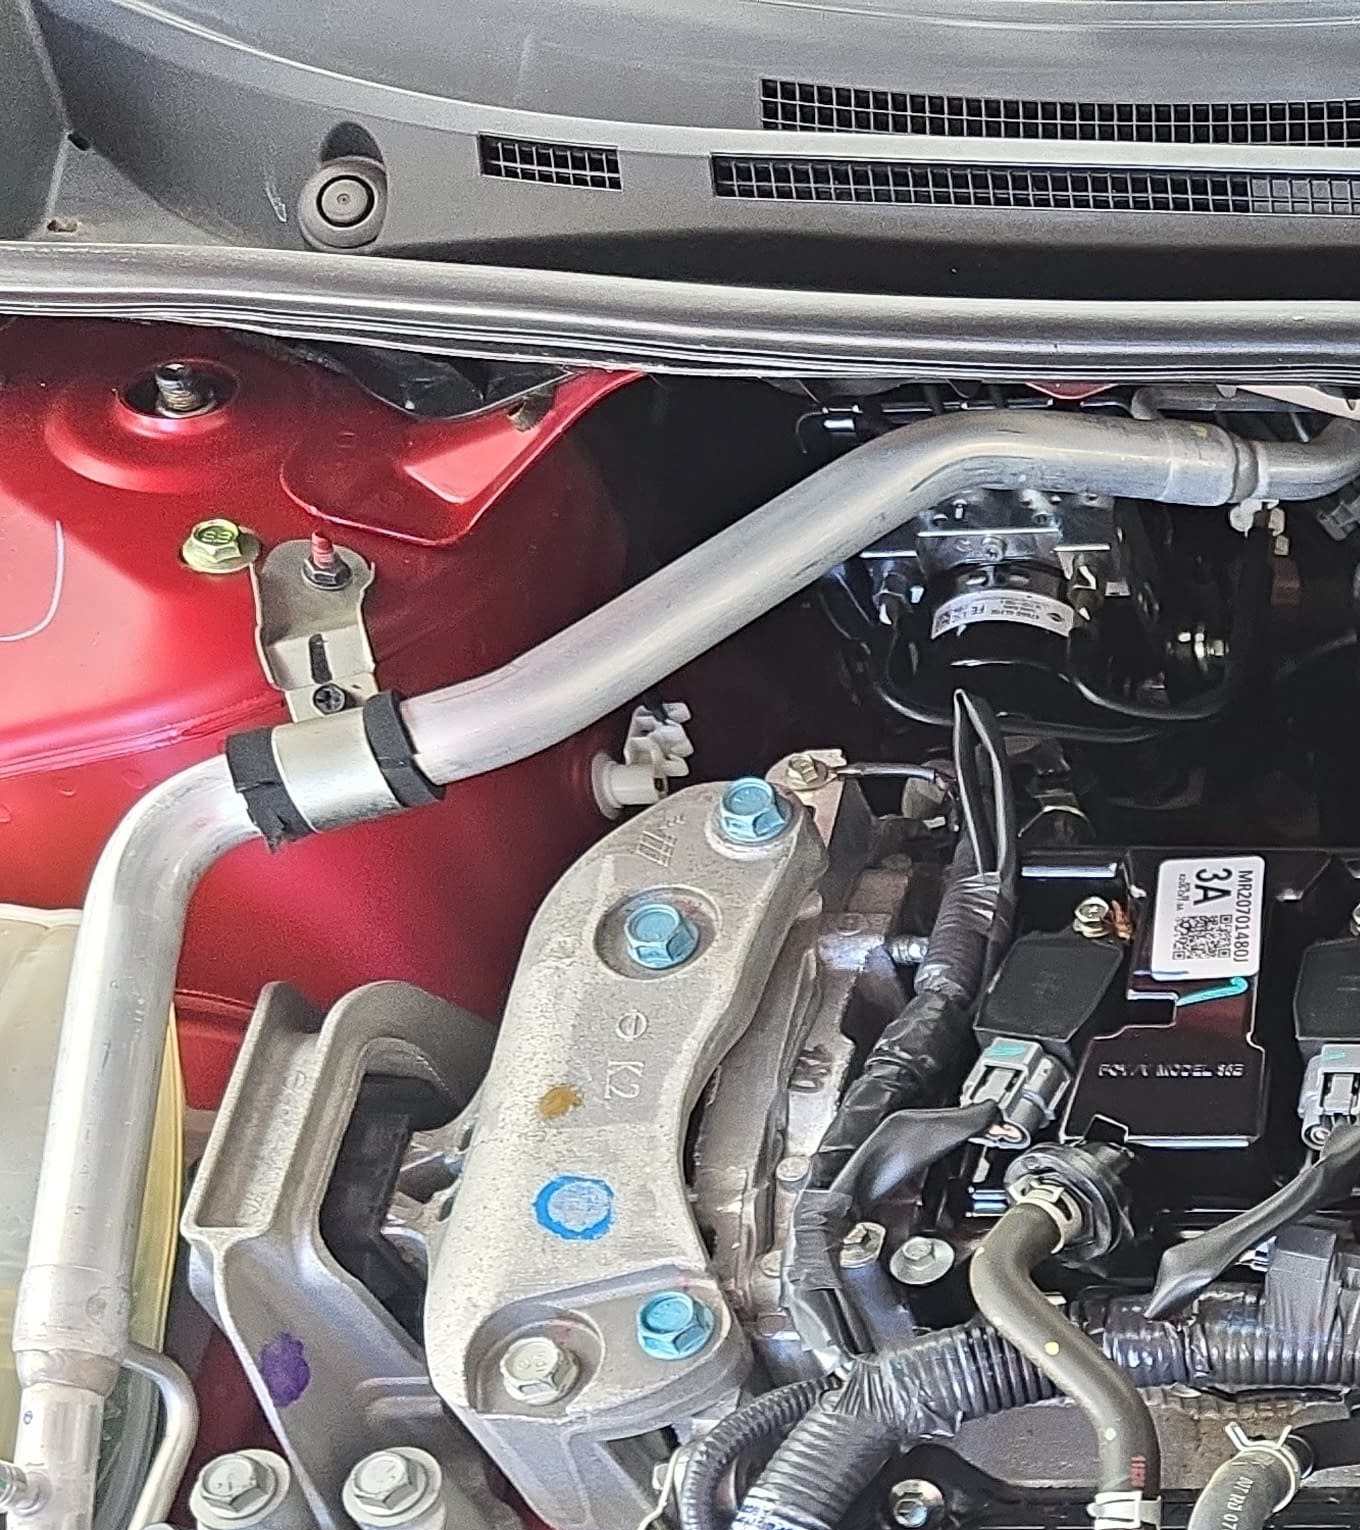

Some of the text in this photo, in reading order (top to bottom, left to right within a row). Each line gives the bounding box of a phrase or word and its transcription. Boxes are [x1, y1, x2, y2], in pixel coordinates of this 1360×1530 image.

[1193, 867, 1233, 906] 3A
[1233, 869, 1255, 963] MR20701480J
[604, 1060, 645, 1100] K2
